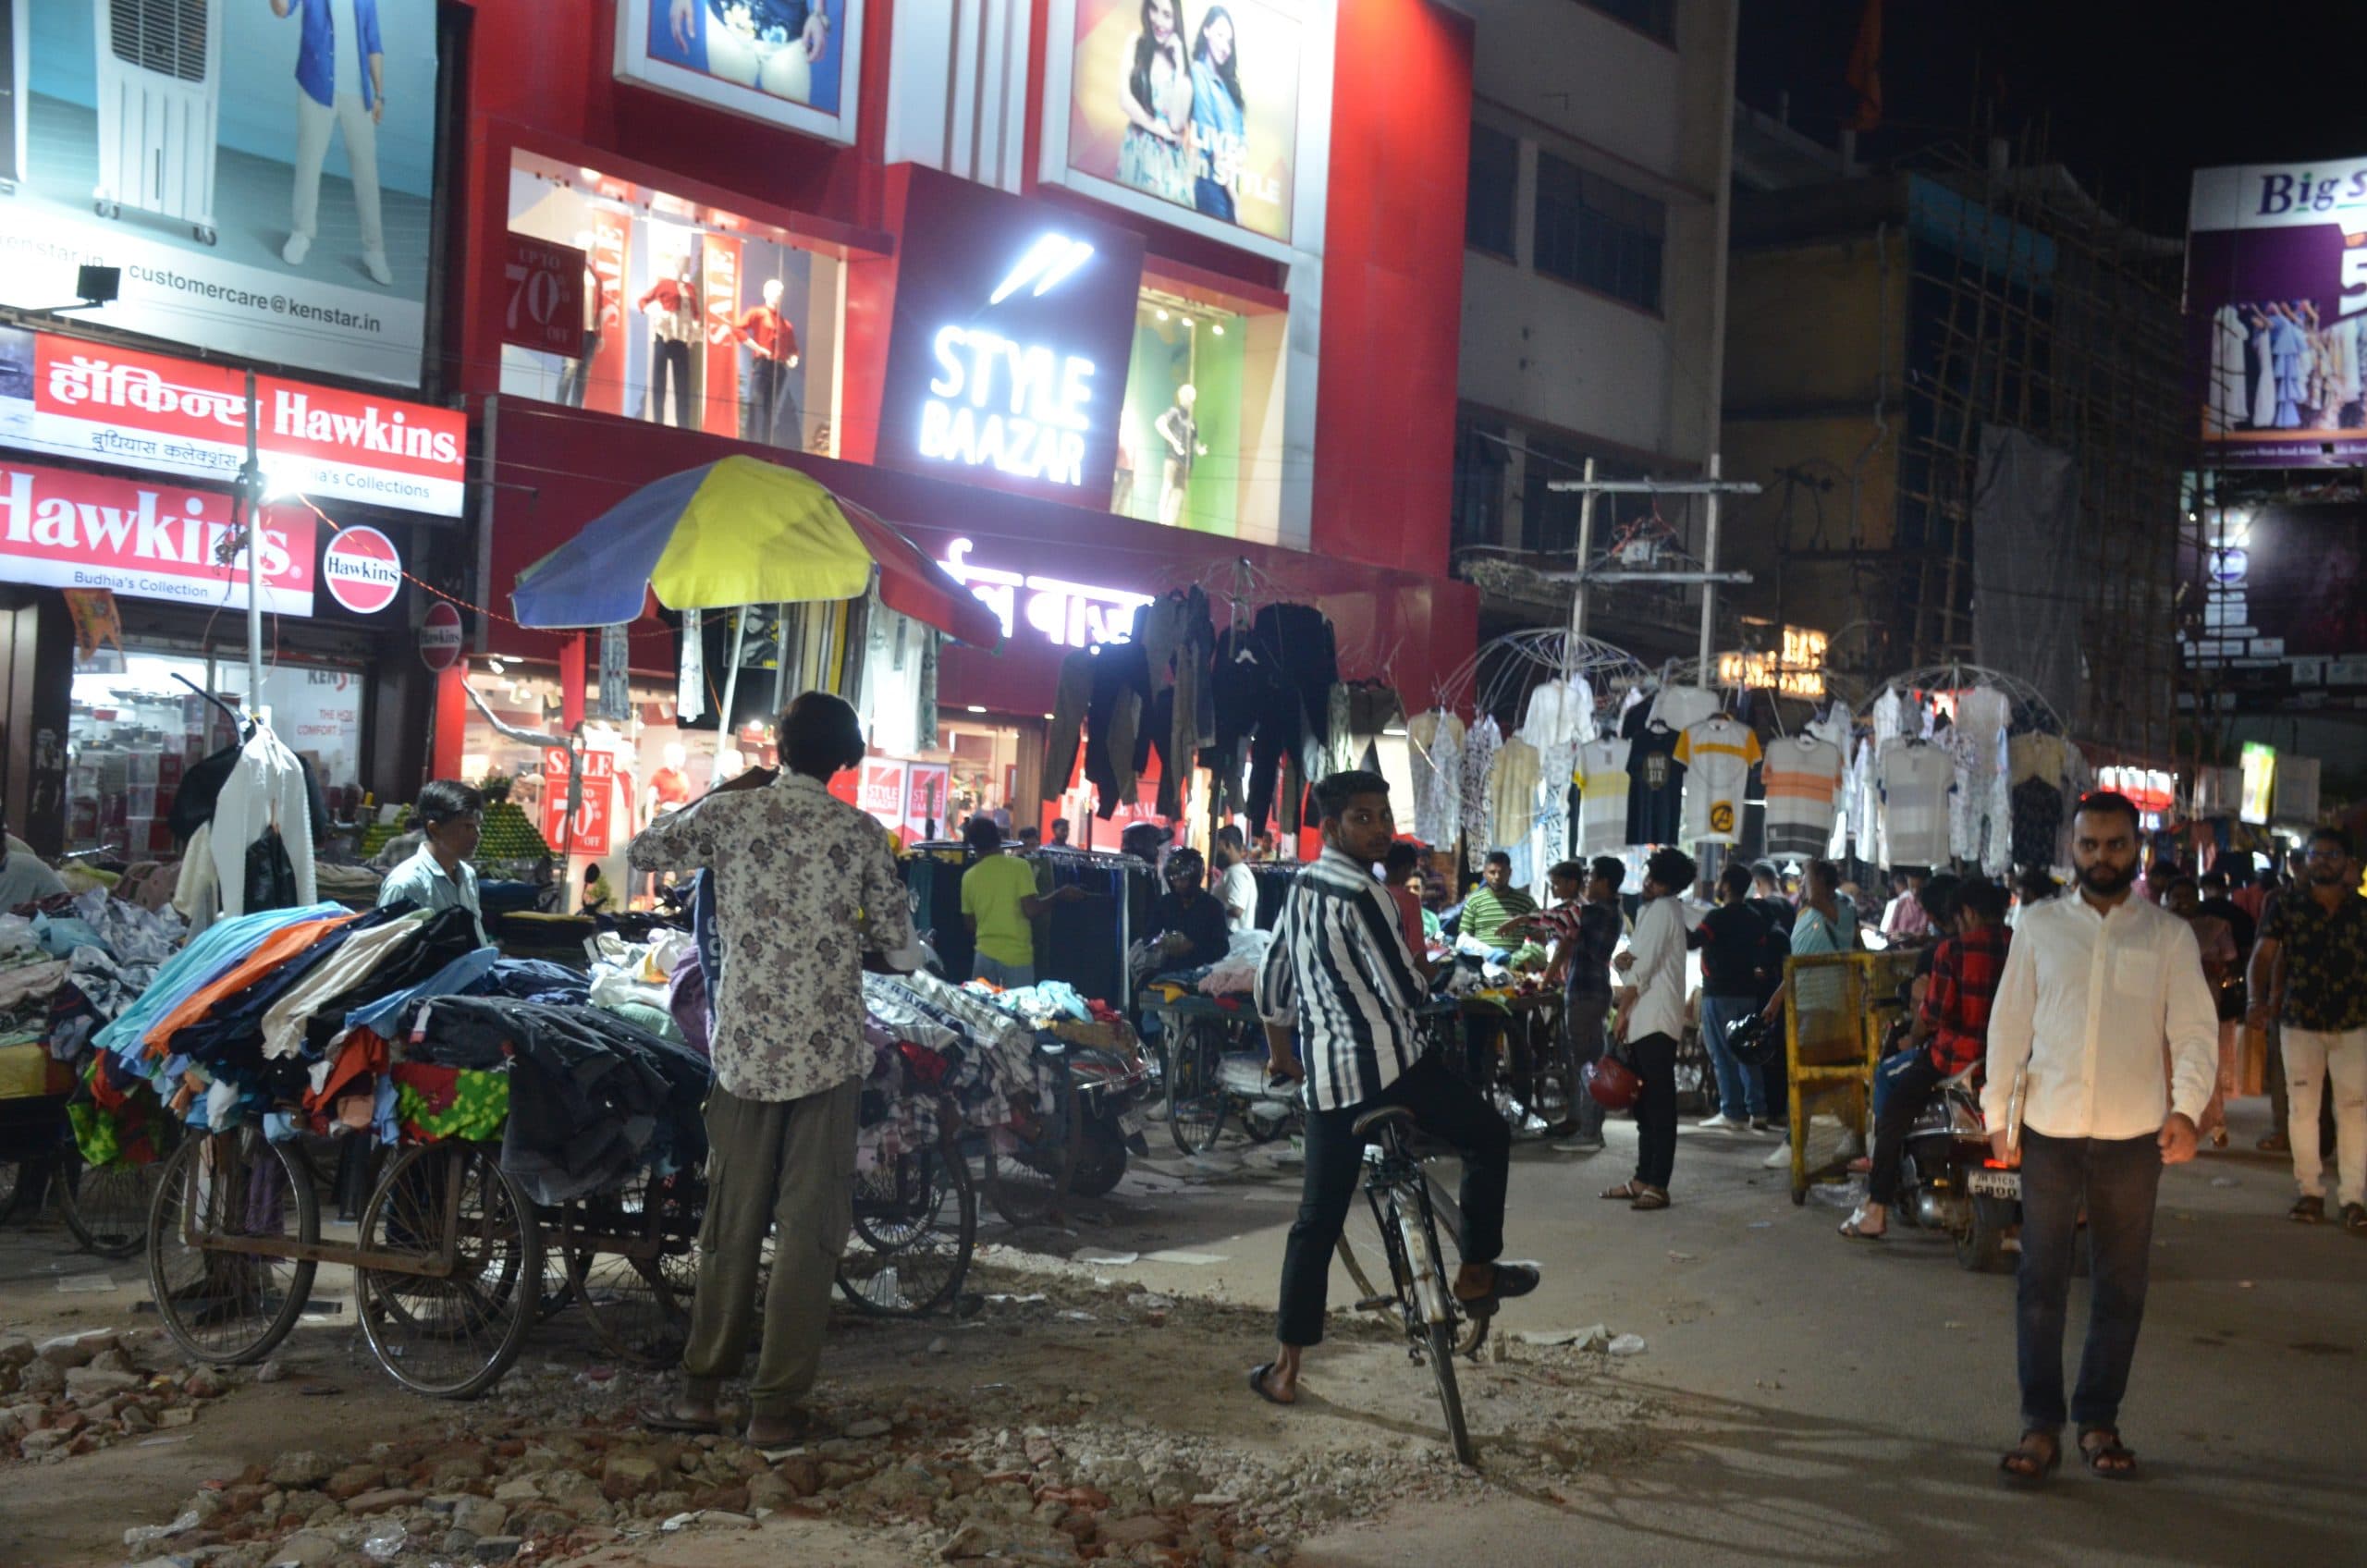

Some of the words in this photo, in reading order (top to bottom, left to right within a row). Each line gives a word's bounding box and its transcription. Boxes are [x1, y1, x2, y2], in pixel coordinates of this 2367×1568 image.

[129, 264, 381, 333] customercare@kenstar.in
[708, 249, 735, 347] SALE
[931, 325, 1096, 431] STYLE
[274, 389, 457, 463] Hawkins
[919, 400, 1085, 485] BAAZAR
[345, 472, 430, 499] Collections
[74, 570, 135, 590] Budhia's
[140, 580, 209, 598] Collection
[328, 556, 398, 582] Hawkins
[548, 750, 612, 778] SLE
